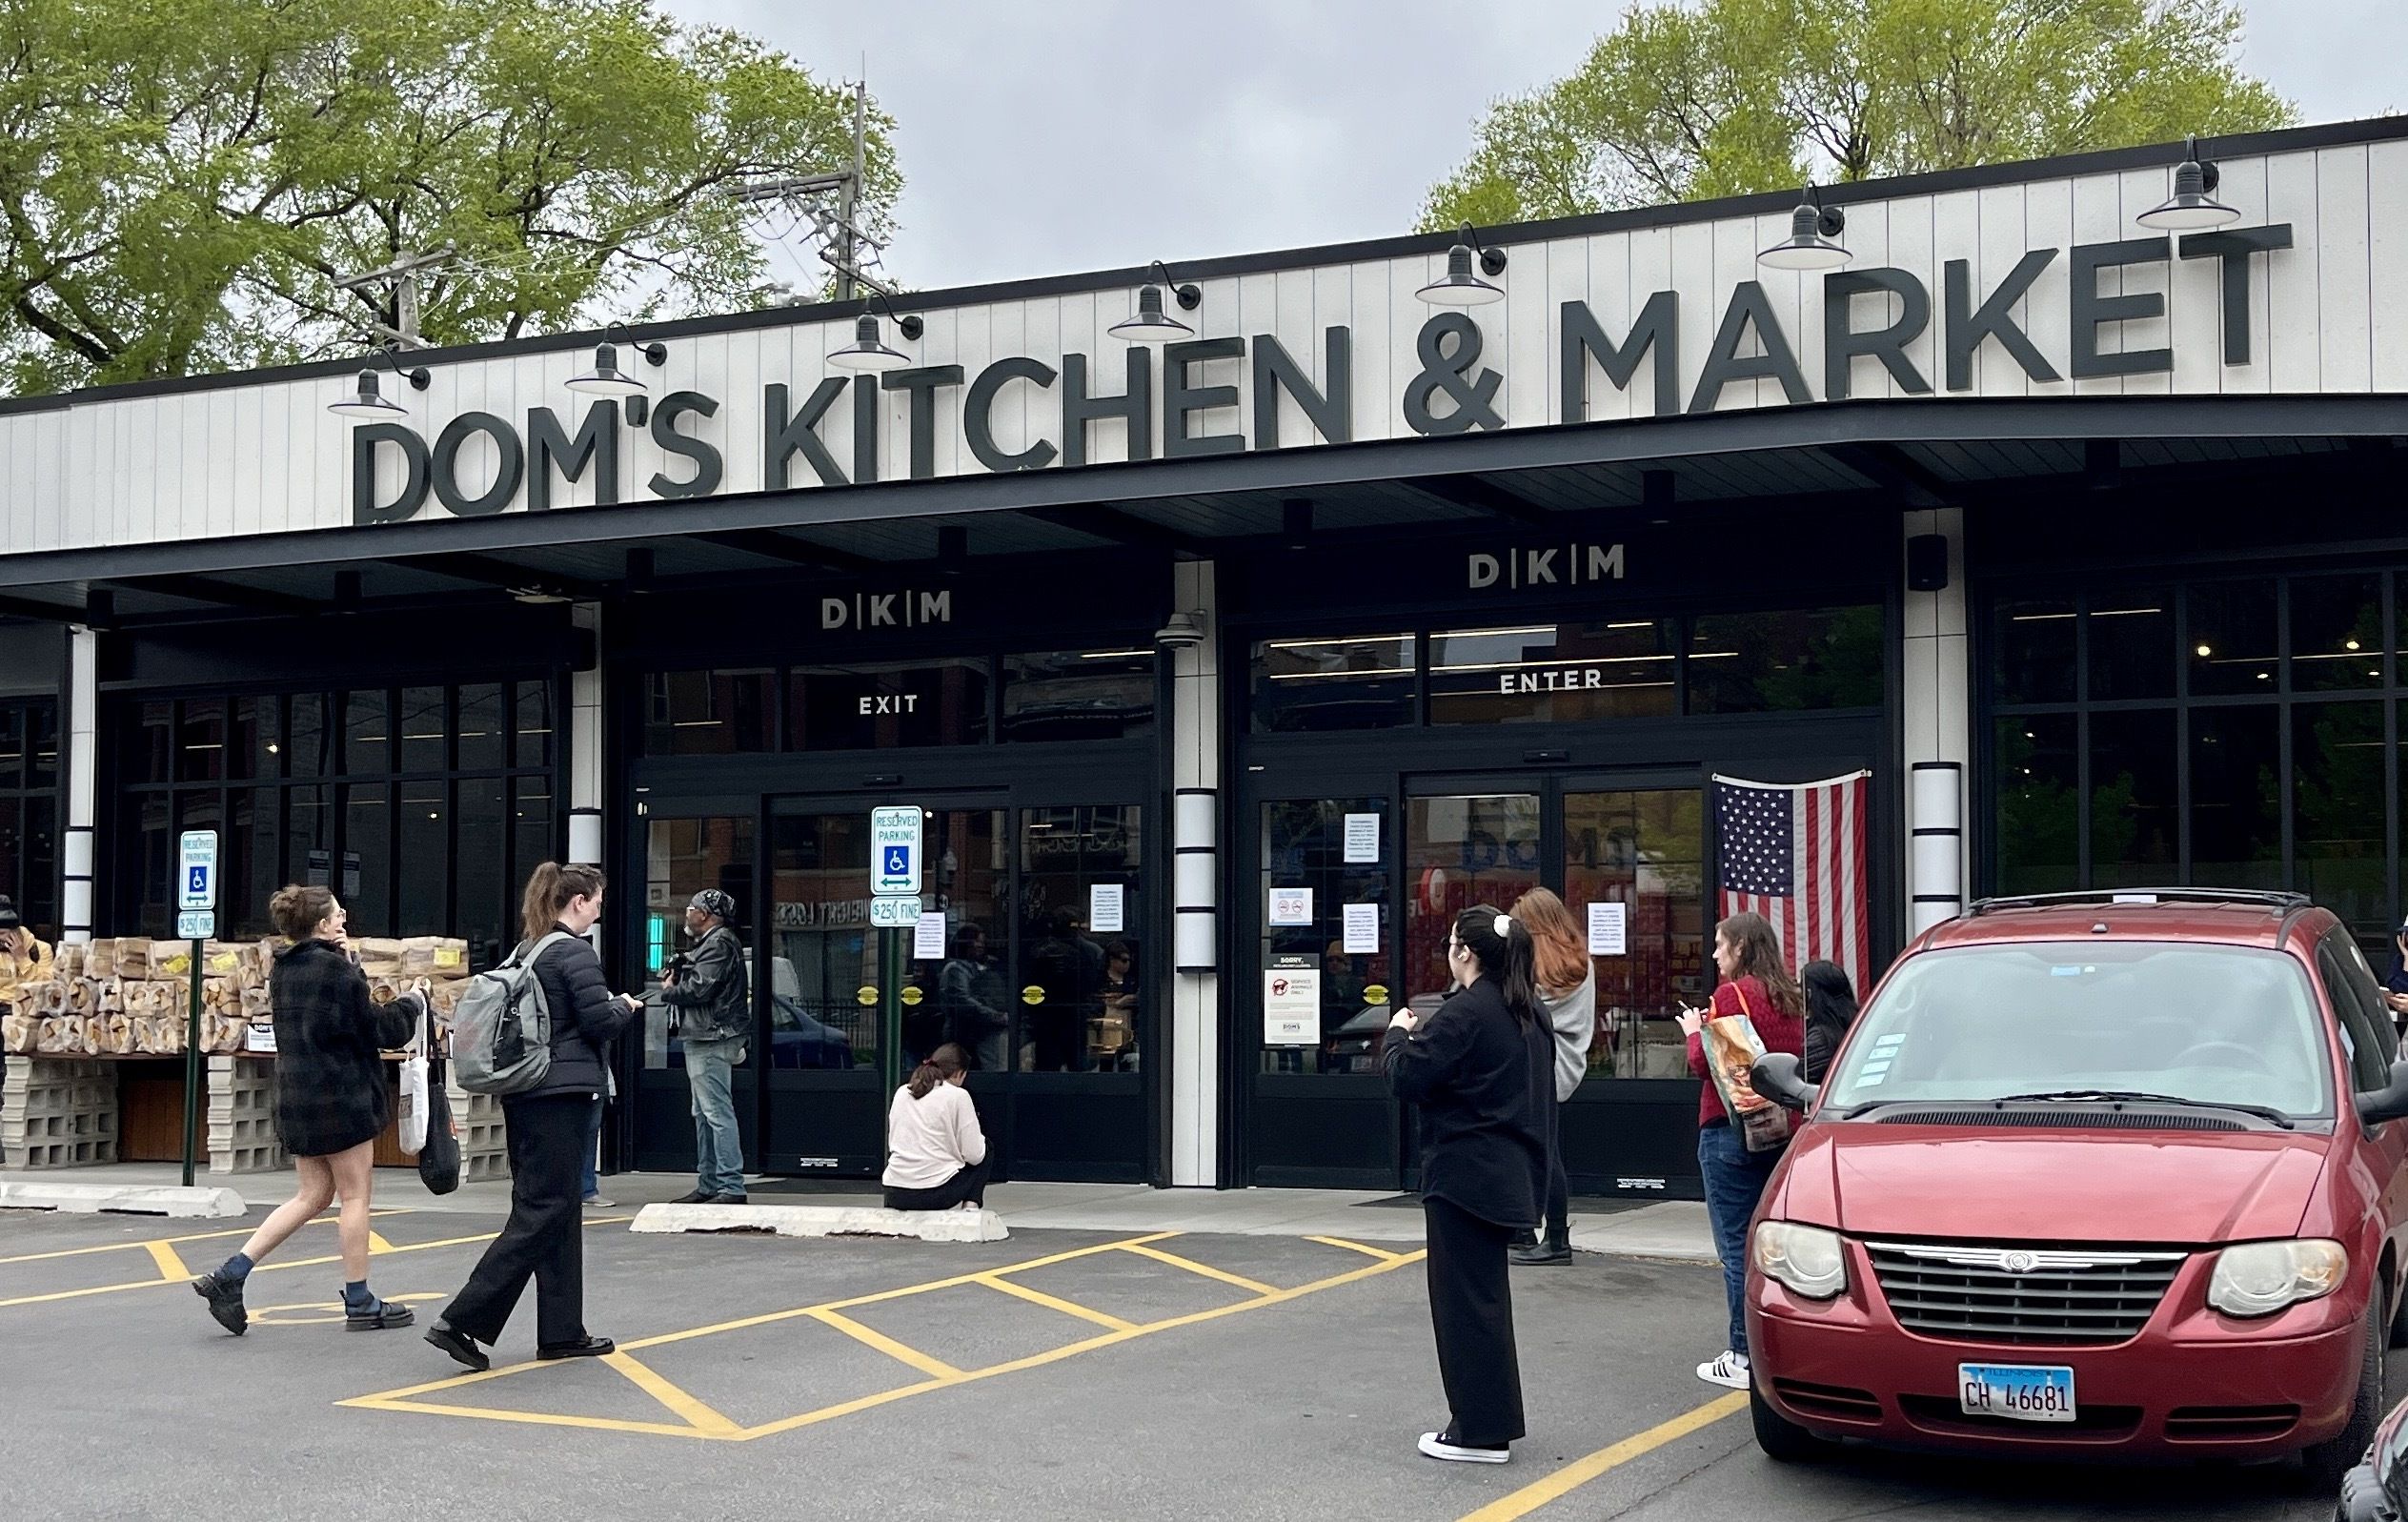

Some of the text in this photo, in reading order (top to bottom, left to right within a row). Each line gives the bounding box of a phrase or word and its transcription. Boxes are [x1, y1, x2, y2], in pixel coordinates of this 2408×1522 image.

[354, 223, 2293, 527] DOM'S KITCHEN & MARKET
[1500, 669, 1602, 695] ENTER
[860, 695, 918, 715] EXIT
[876, 815, 918, 827] RESERVED
[878, 830, 916, 842] PARKING
[185, 852, 212, 862] PARKING
[873, 903, 920, 920] $250 FINE
[199, 918, 212, 932] FINE
[1989, 1369, 2045, 1378] ILLINOIS
[1965, 1382, 2070, 1412] CH 46681
